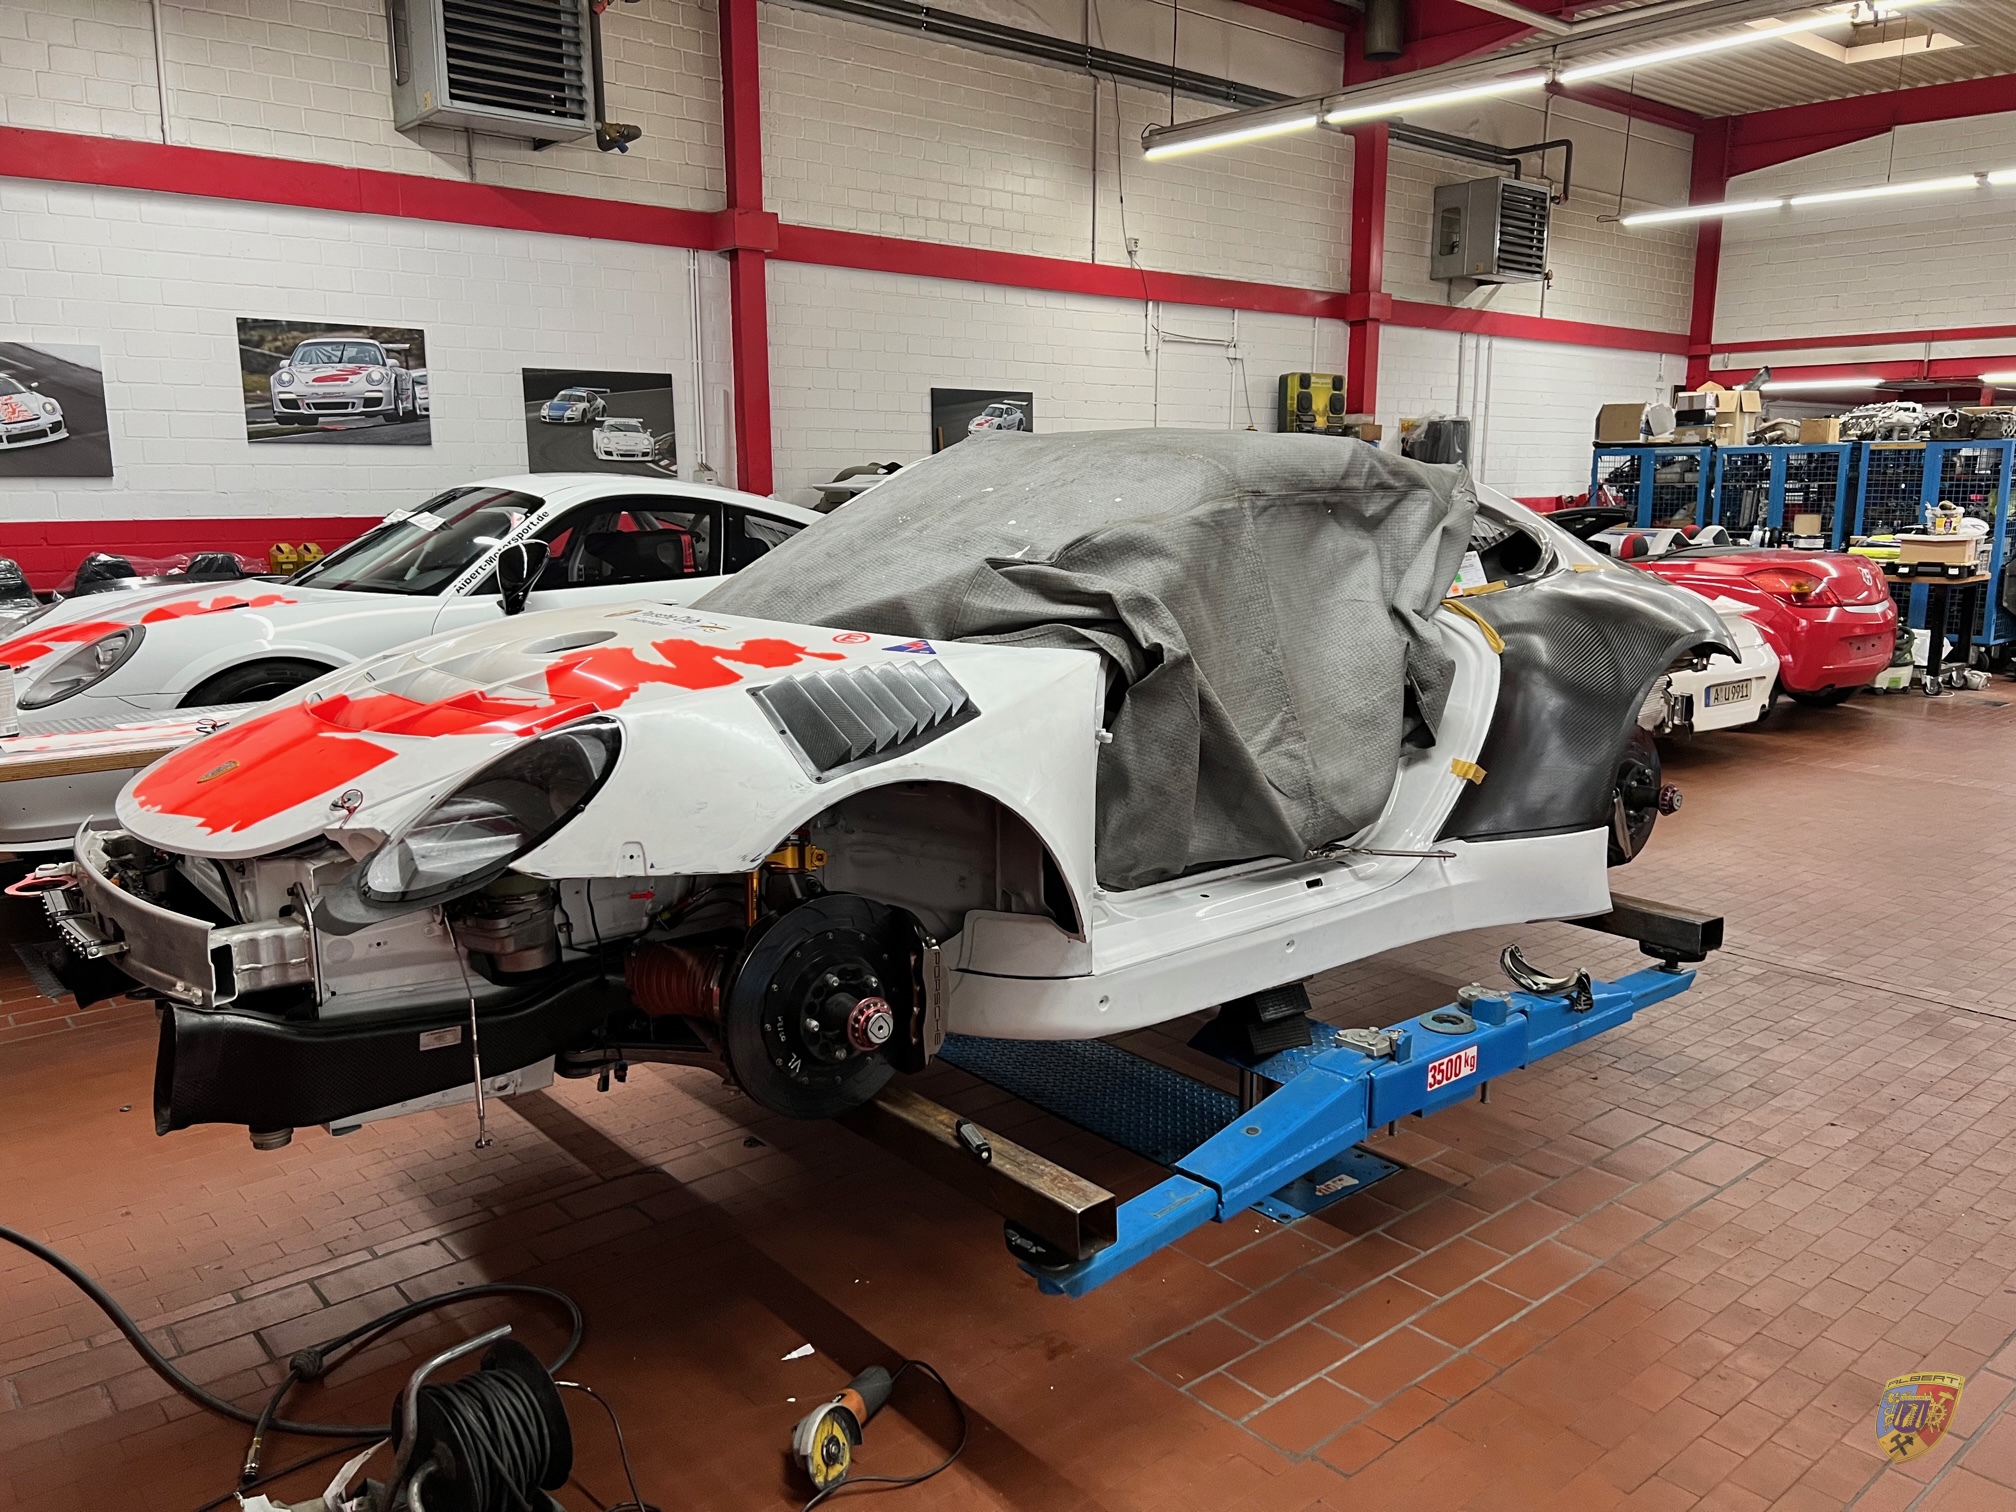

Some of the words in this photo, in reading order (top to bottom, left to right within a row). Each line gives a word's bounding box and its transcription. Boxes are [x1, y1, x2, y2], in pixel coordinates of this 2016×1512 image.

[453, 510, 550, 594] Albert-Morsport.de
[933, 951, 942, 1046] PORSCHE
[1429, 1054, 1462, 1089] 3500
[1464, 1051, 1476, 1072] kg
